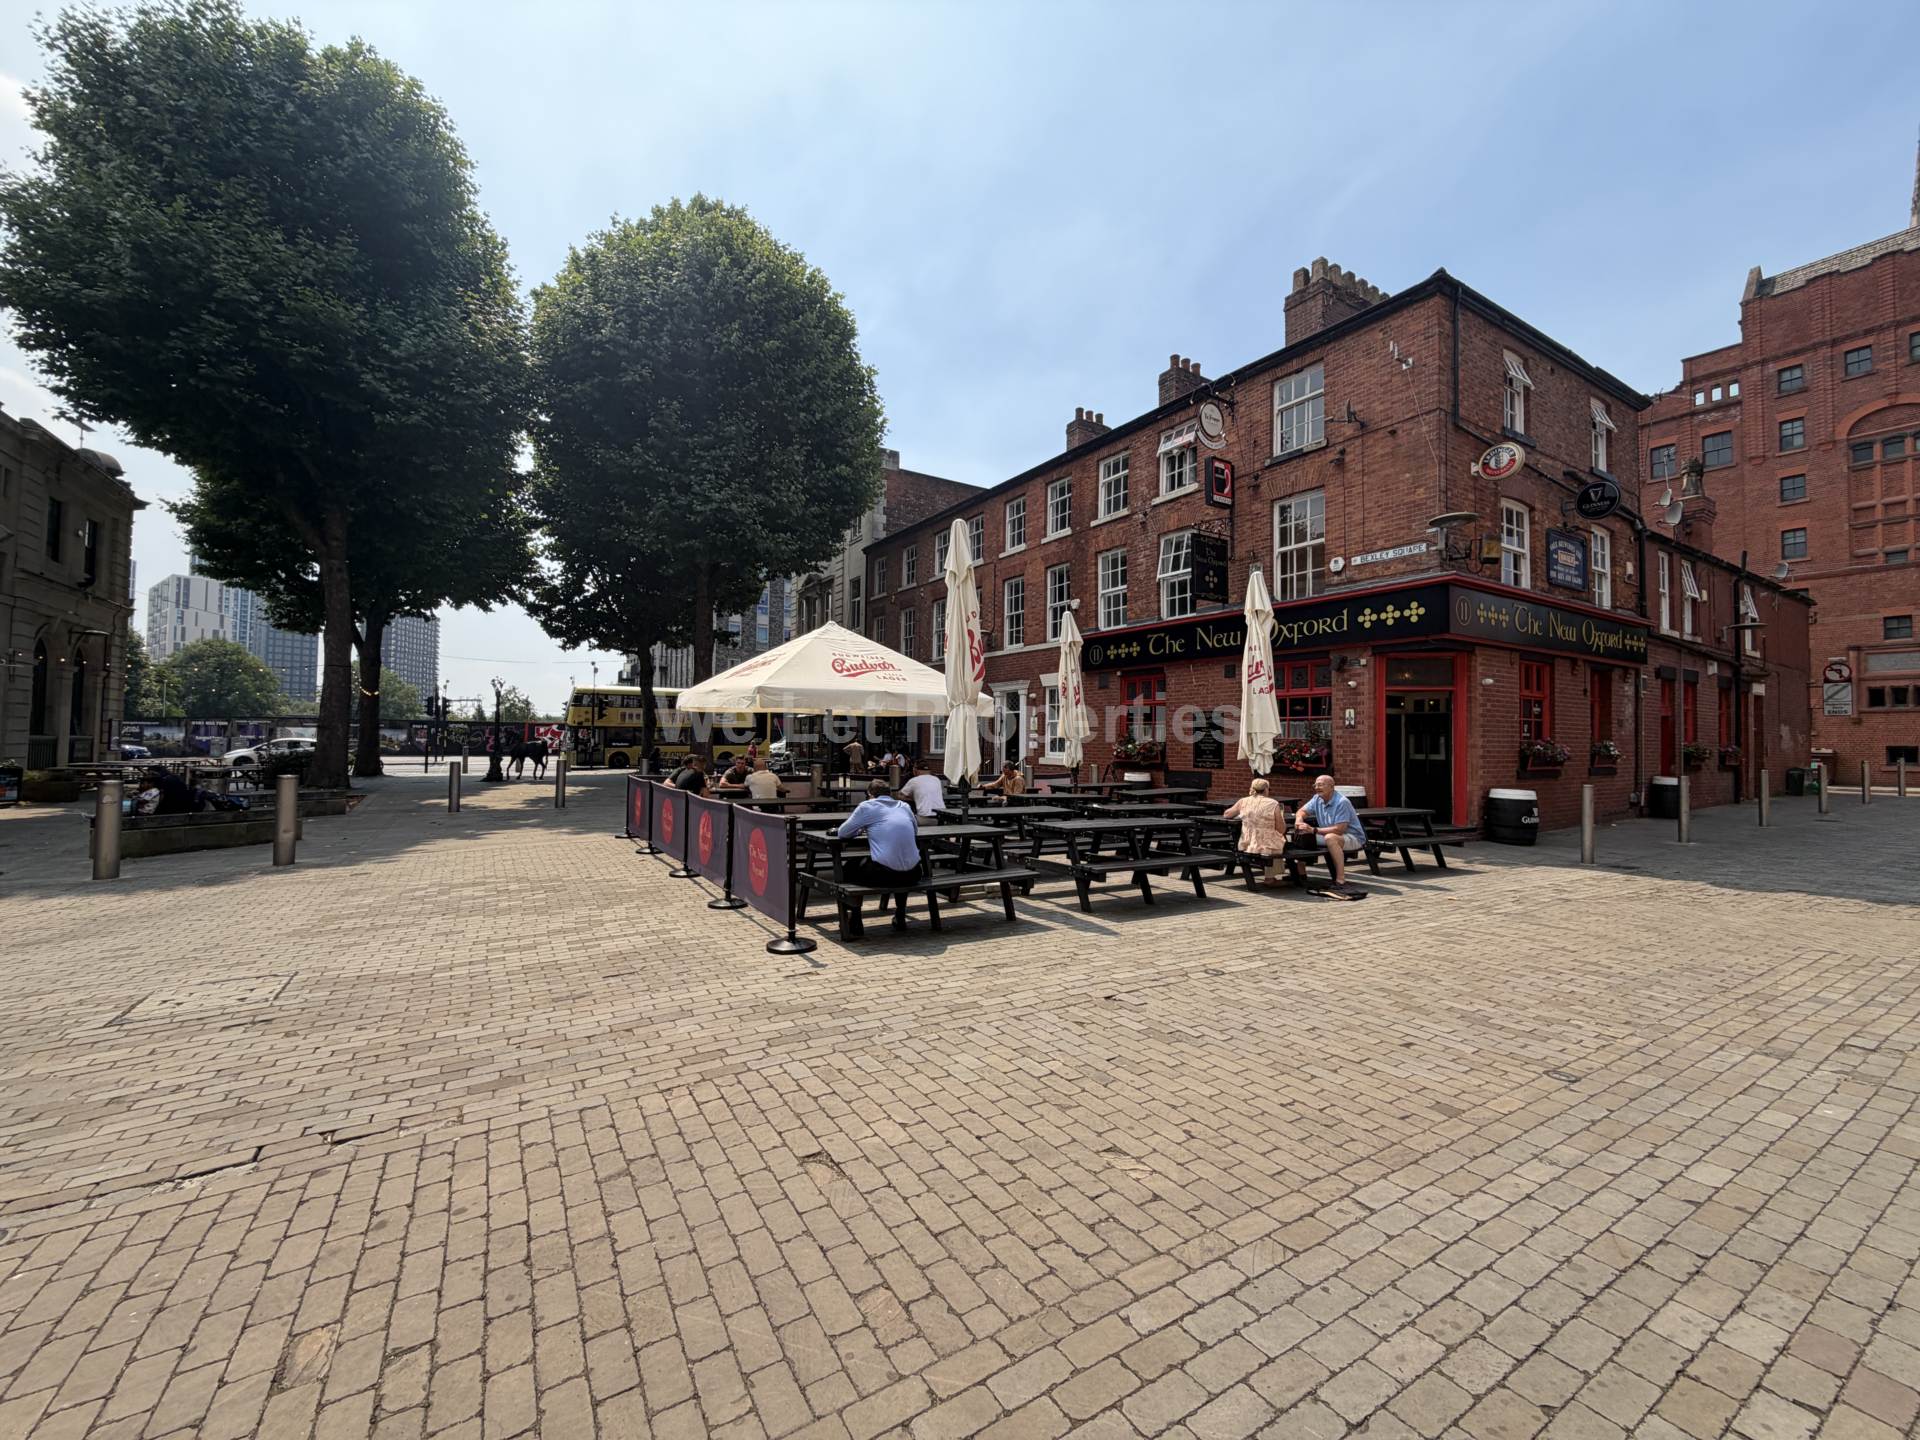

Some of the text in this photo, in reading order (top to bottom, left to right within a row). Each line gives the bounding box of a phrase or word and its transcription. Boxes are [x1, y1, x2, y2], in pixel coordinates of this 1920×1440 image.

[1360, 544, 1424, 563] BEXLEY SQUARE
[1512, 601, 1543, 636] The
[1550, 611, 1576, 642] New
[1147, 633, 1185, 655] The
[1196, 625, 1241, 650] New
[831, 657, 897, 675] Budvar
